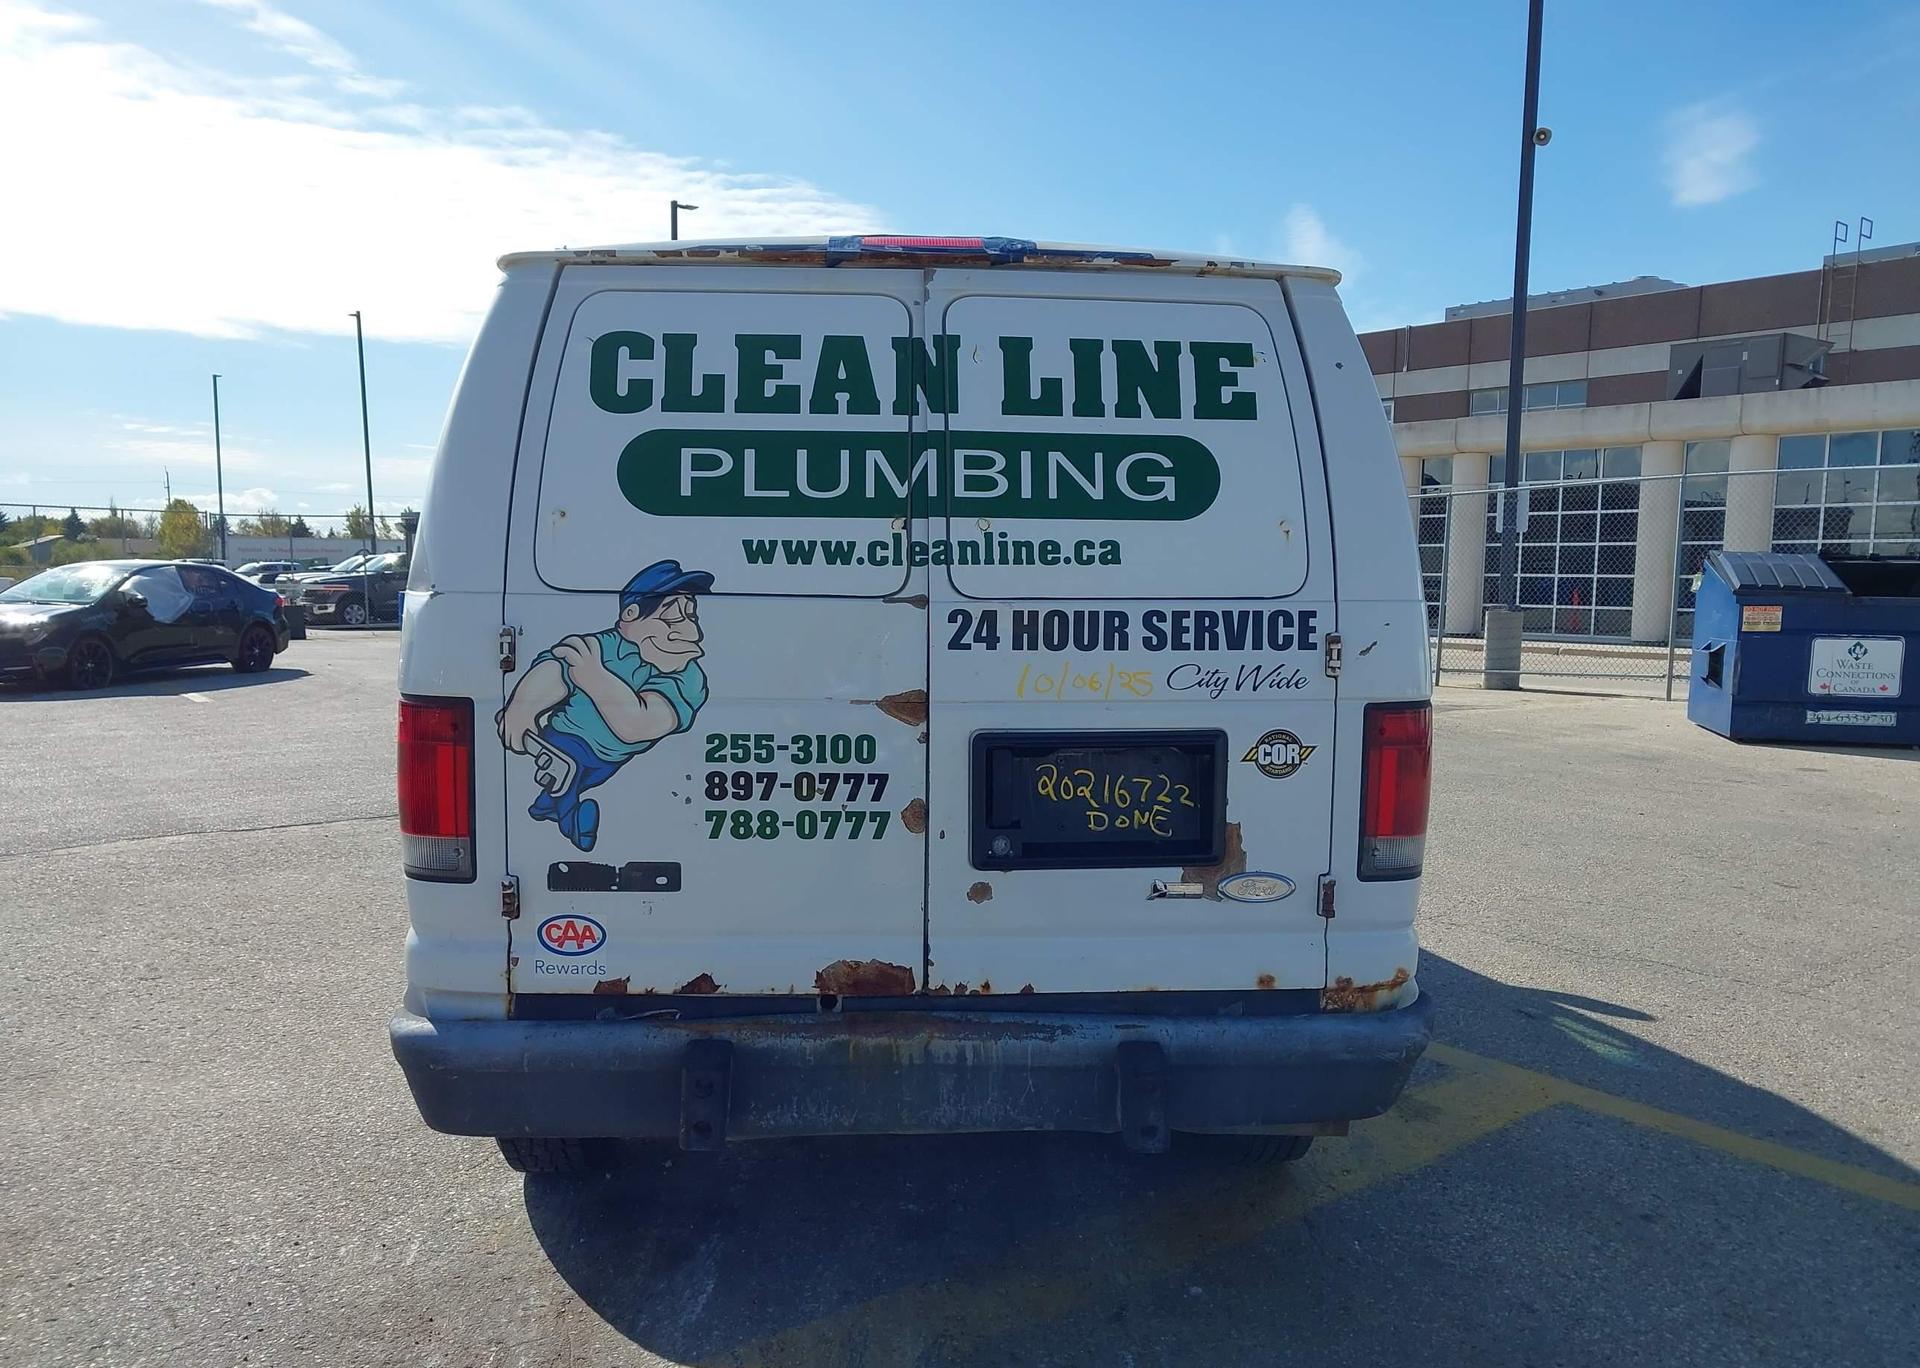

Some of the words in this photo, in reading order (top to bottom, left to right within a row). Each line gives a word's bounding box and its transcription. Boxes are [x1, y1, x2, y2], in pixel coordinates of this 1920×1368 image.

[590, 331, 960, 415] CLEAN
[999, 336, 1258, 420] LINE
[680, 447, 1176, 502] PLUMBING
[742, 532, 1121, 567] www.cleanline.ca
[947, 609, 1000, 651] 24
[1011, 610, 1129, 651] HOUR
[1142, 609, 1318, 651] SERVICE
[1816, 668, 1896, 679] CONNECTIONS
[1836, 659, 1873, 670] WASTE
[1016, 661, 1154, 700] 10/06/25
[1166, 663, 1230, 699] City
[1235, 664, 1310, 692] Wide
[1833, 683, 1876, 693] CANADA
[705, 733, 876, 764] 255-3100
[1258, 744, 1300, 765] COR
[704, 771, 889, 802] 897-0777
[705, 810, 891, 840] 788-0777
[545, 920, 597, 950] CAA
[535, 960, 606, 975] Rewards
